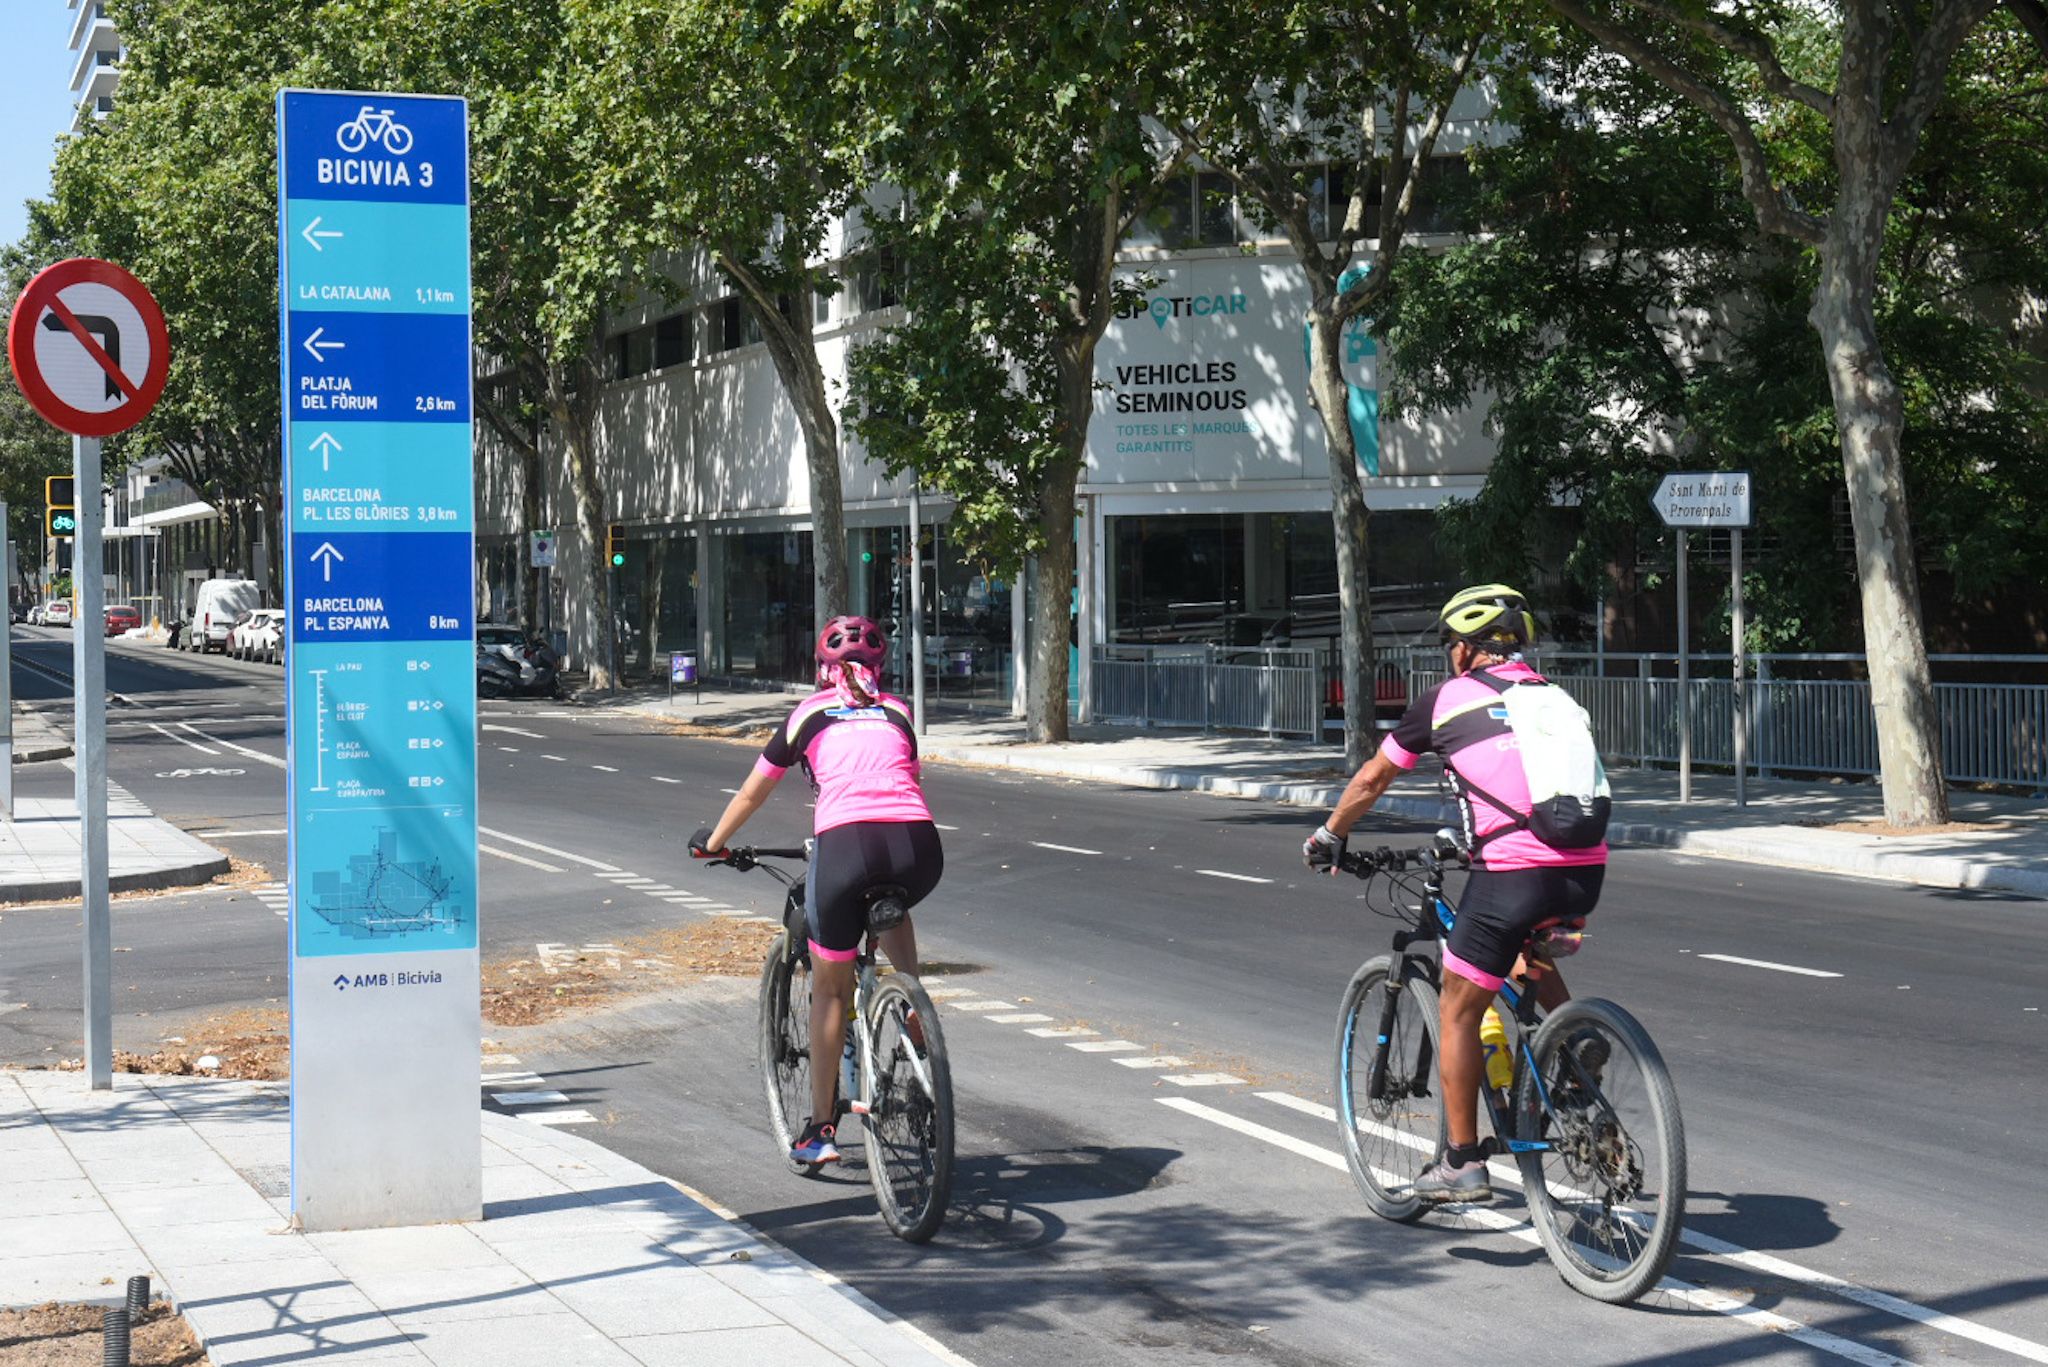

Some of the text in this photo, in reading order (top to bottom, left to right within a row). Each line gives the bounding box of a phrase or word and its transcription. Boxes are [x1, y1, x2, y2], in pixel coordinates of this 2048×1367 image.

[317, 158, 434, 188] BICIVIA 3
[300, 285, 391, 301] LA CATALANA
[416, 288, 454, 304] 1,1 km
[1116, 361, 1237, 385] VEHICLES
[301, 376, 352, 391] PLATJA
[302, 392, 378, 410] DEL FÒRUM
[415, 396, 456, 413] 2,6 km
[1116, 389, 1247, 414] SEMINOUS
[1116, 421, 1258, 438] TOTES LES MARQUES
[1116, 440, 1193, 454] GARANTITS
[303, 488, 382, 502] BARCELONA
[1669, 482, 1693, 497] Sant
[1732, 481, 1746, 496] de
[303, 504, 410, 521] PL. LES GLÒRIES
[418, 507, 457, 522] 3,8 km
[304, 598, 384, 613] BARCELONA
[304, 616, 390, 631] PL. ESPANYA
[429, 616, 459, 630] 8 km
[353, 970, 442, 988] AMB Bicivia
